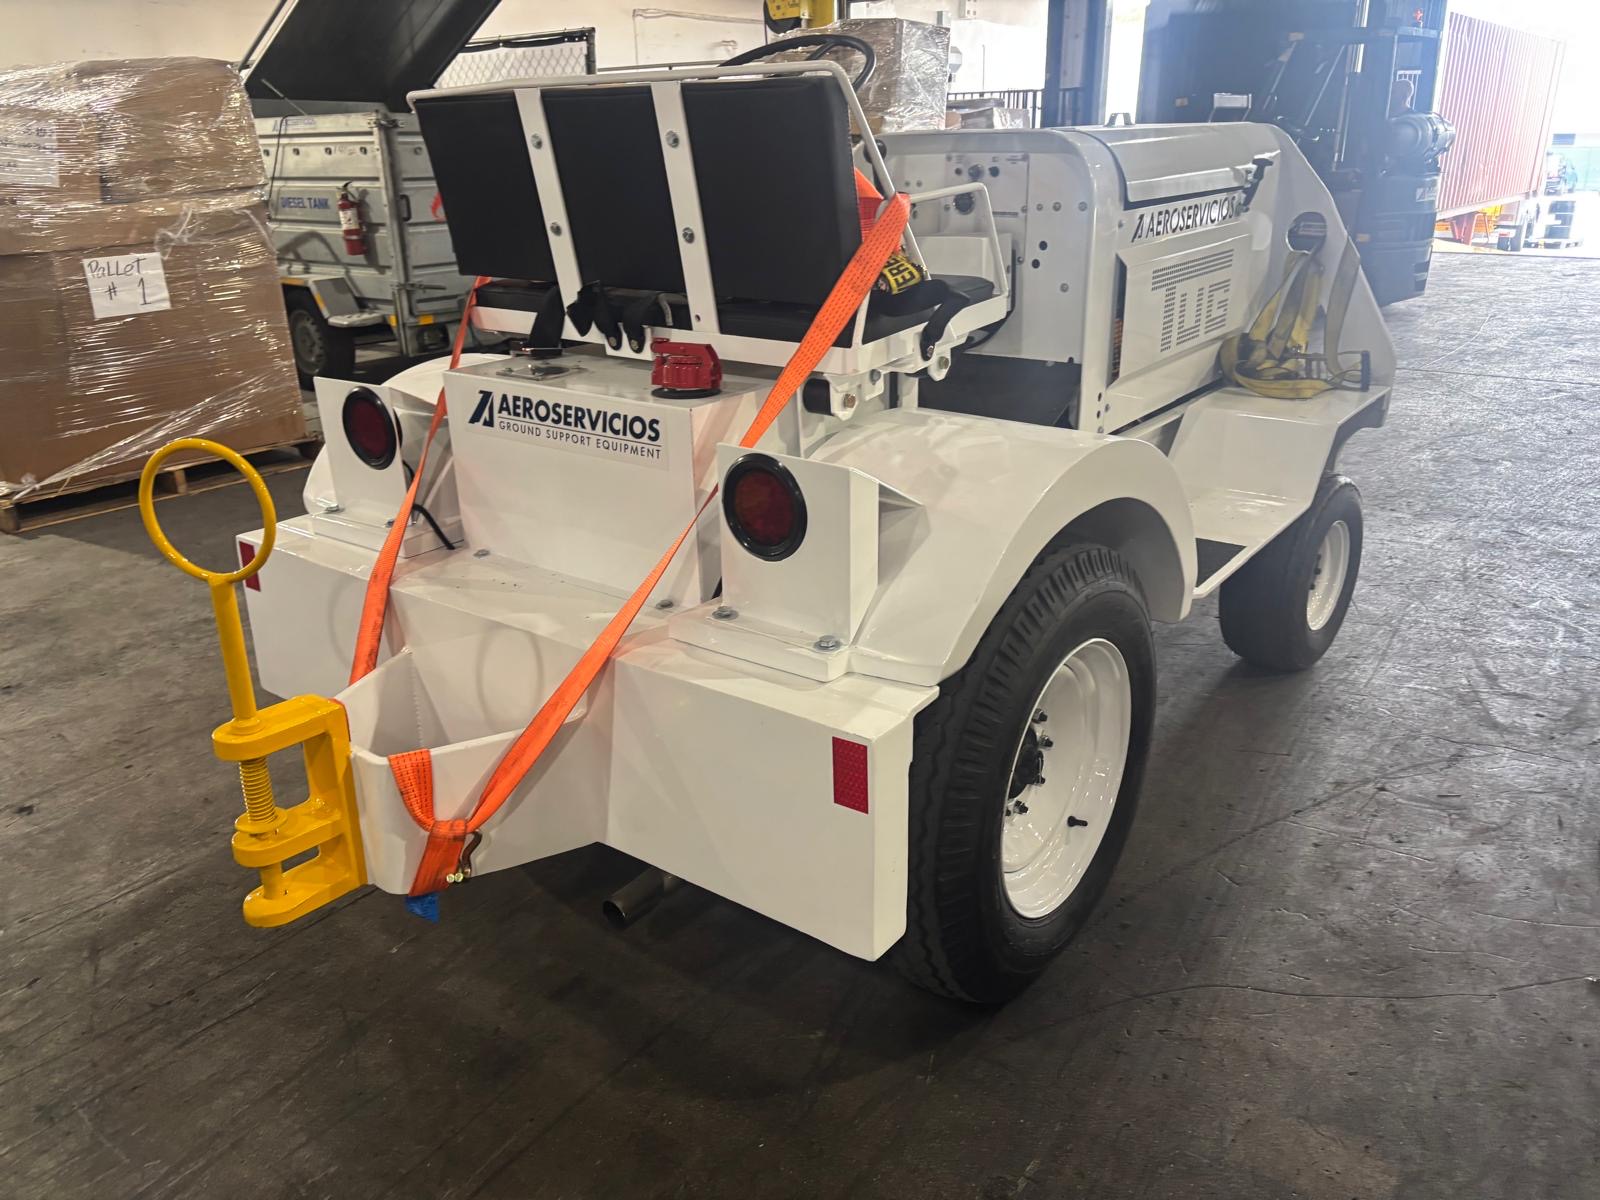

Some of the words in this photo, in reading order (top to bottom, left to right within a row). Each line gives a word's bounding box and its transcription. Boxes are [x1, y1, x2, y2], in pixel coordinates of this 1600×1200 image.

[280, 196, 307, 209] DIESEL
[307, 197, 330, 210] TANK
[1146, 195, 1236, 240] AEROSERVICIOS
[104, 281, 118, 301] #
[137, 277, 152, 306] 1
[1151, 249, 1234, 353] TUG
[497, 393, 661, 443] AEROSERVICIOS
[498, 420, 542, 438] GROUND
[545, 428, 592, 446] SUPPORT
[595, 437, 662, 460] EQUIPMENT
